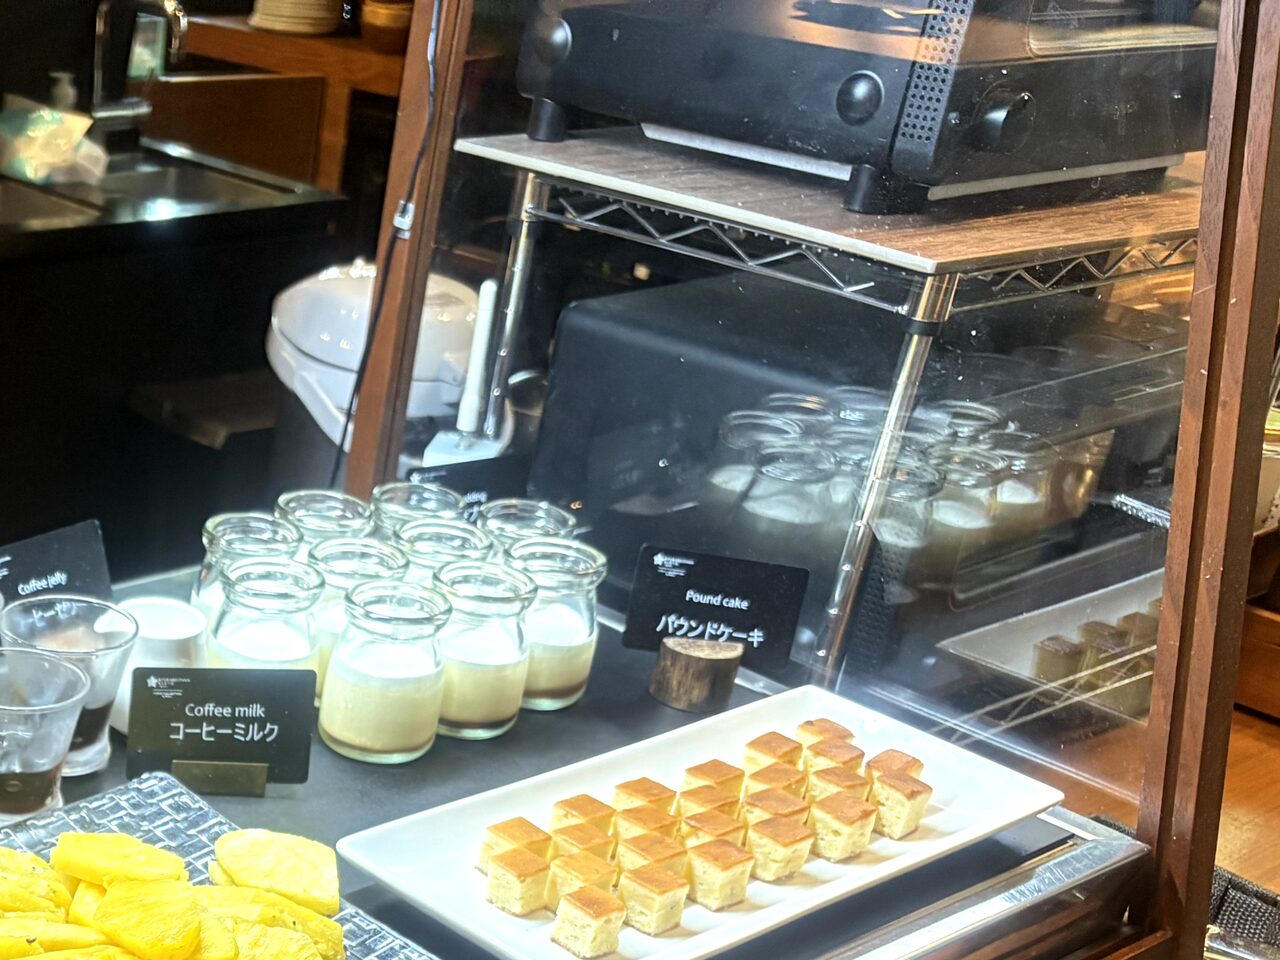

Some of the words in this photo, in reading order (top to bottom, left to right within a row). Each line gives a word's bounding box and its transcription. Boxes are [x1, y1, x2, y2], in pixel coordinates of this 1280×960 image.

[17, 578, 48, 596] Coffee
[685, 588, 722, 606] Pound
[722, 596, 749, 610] cake
[656, 613, 764, 648] パウンドケーキ
[185, 702, 232, 717] Coffee
[234, 703, 266, 718] milk
[169, 722, 279, 742] コーヒーミルク
